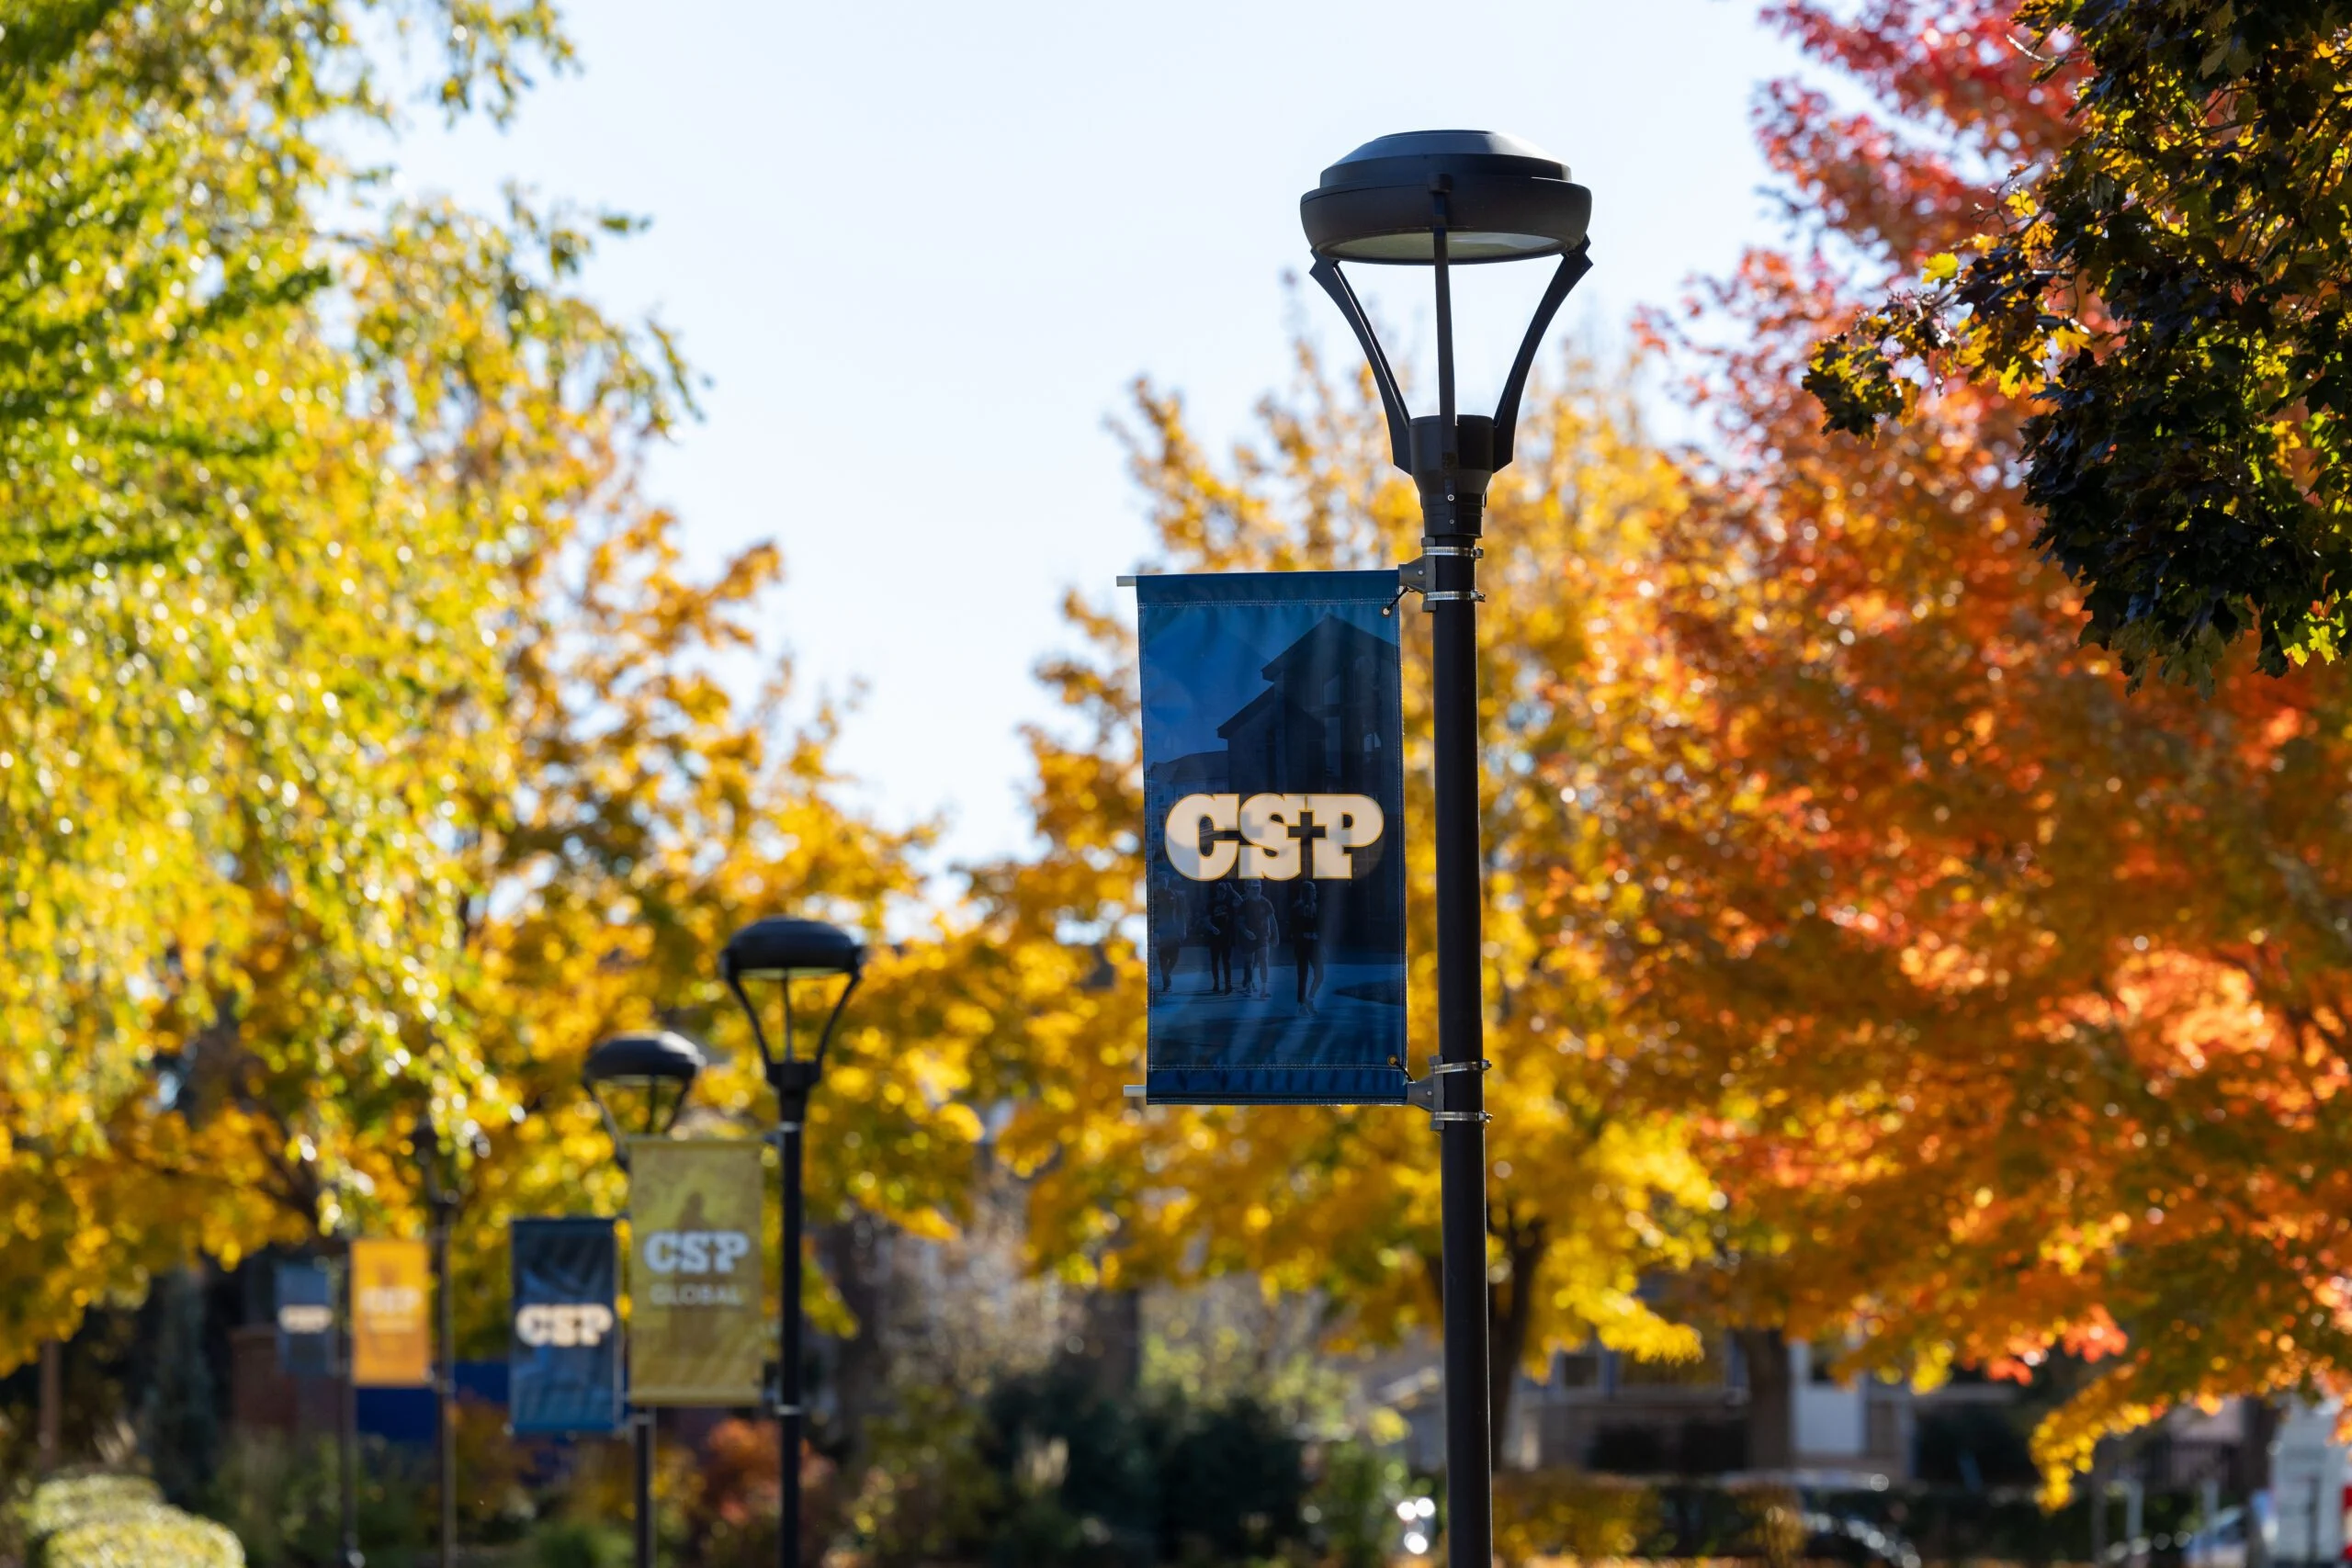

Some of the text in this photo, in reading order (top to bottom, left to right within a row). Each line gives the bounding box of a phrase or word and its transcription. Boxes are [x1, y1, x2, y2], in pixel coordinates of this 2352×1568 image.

[1164, 792, 1385, 882] CSP
[643, 1230, 751, 1274] CSP
[649, 1283, 743, 1306] GLOBAL
[515, 1303, 614, 1348] CSP
